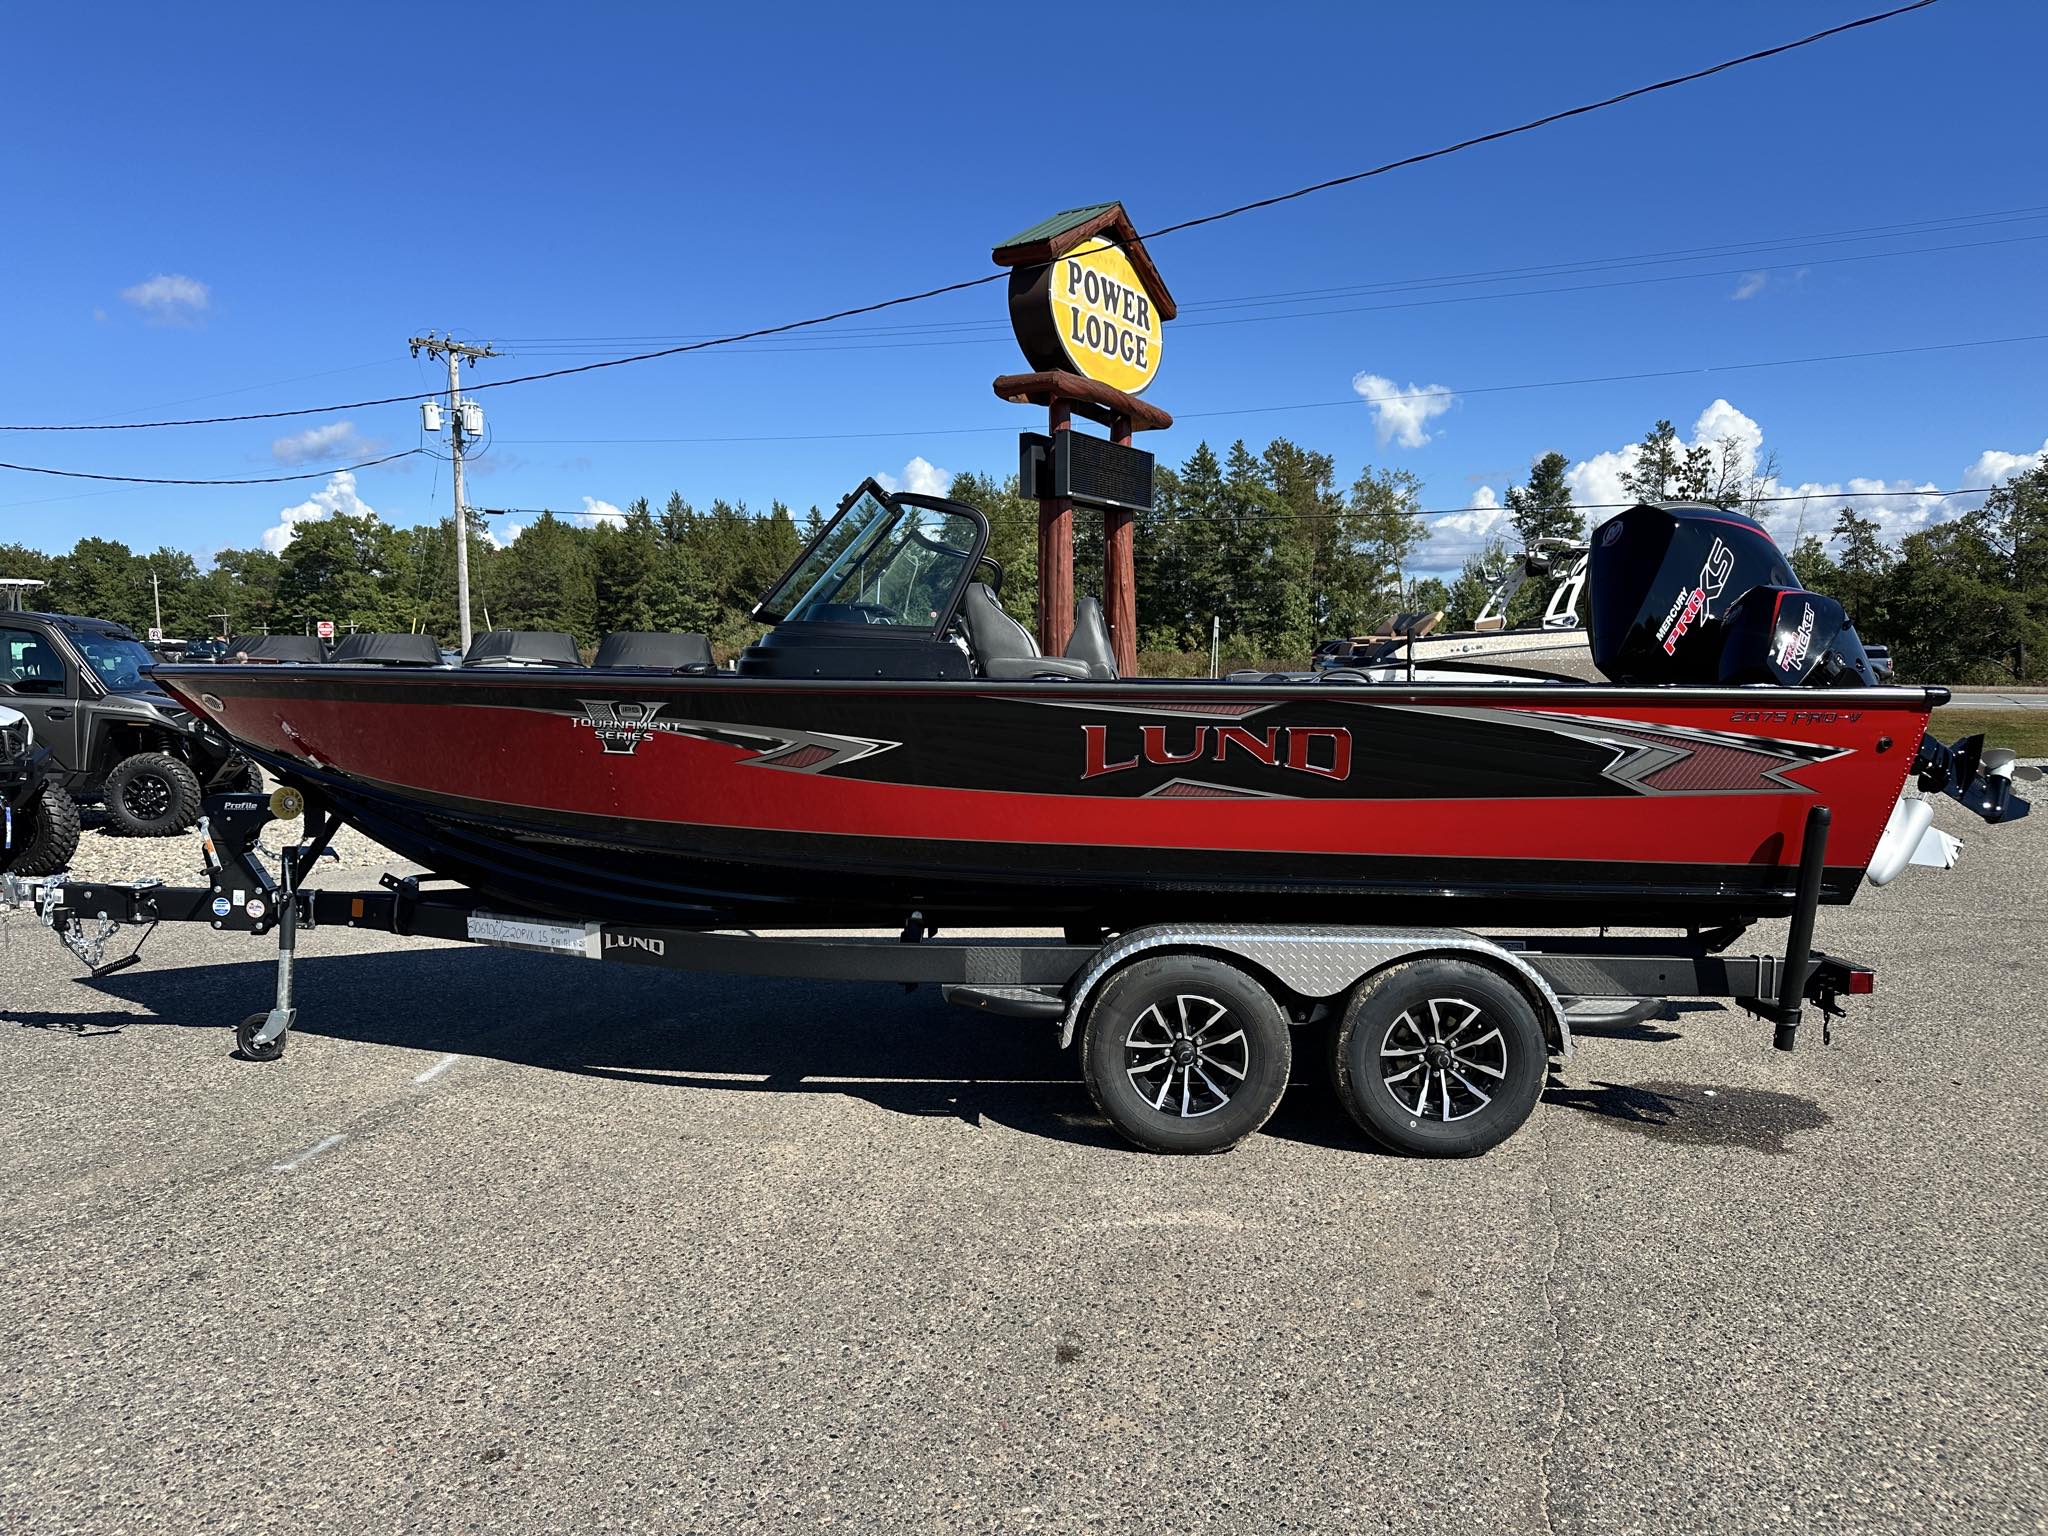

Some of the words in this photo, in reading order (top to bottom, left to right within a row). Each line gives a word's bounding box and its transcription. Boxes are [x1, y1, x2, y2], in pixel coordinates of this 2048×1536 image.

[1067, 259, 1151, 332] POWER
[1071, 306, 1148, 369] LODGE
[1655, 586, 1689, 642] MERCURY
[571, 717, 681, 732] TOURNAMENT
[594, 730, 654, 742] SERIES
[1730, 711, 1787, 723] 2075
[1791, 711, 1864, 726] PRO-V
[1080, 725, 1352, 781] LUND
[605, 933, 665, 956] LUND
